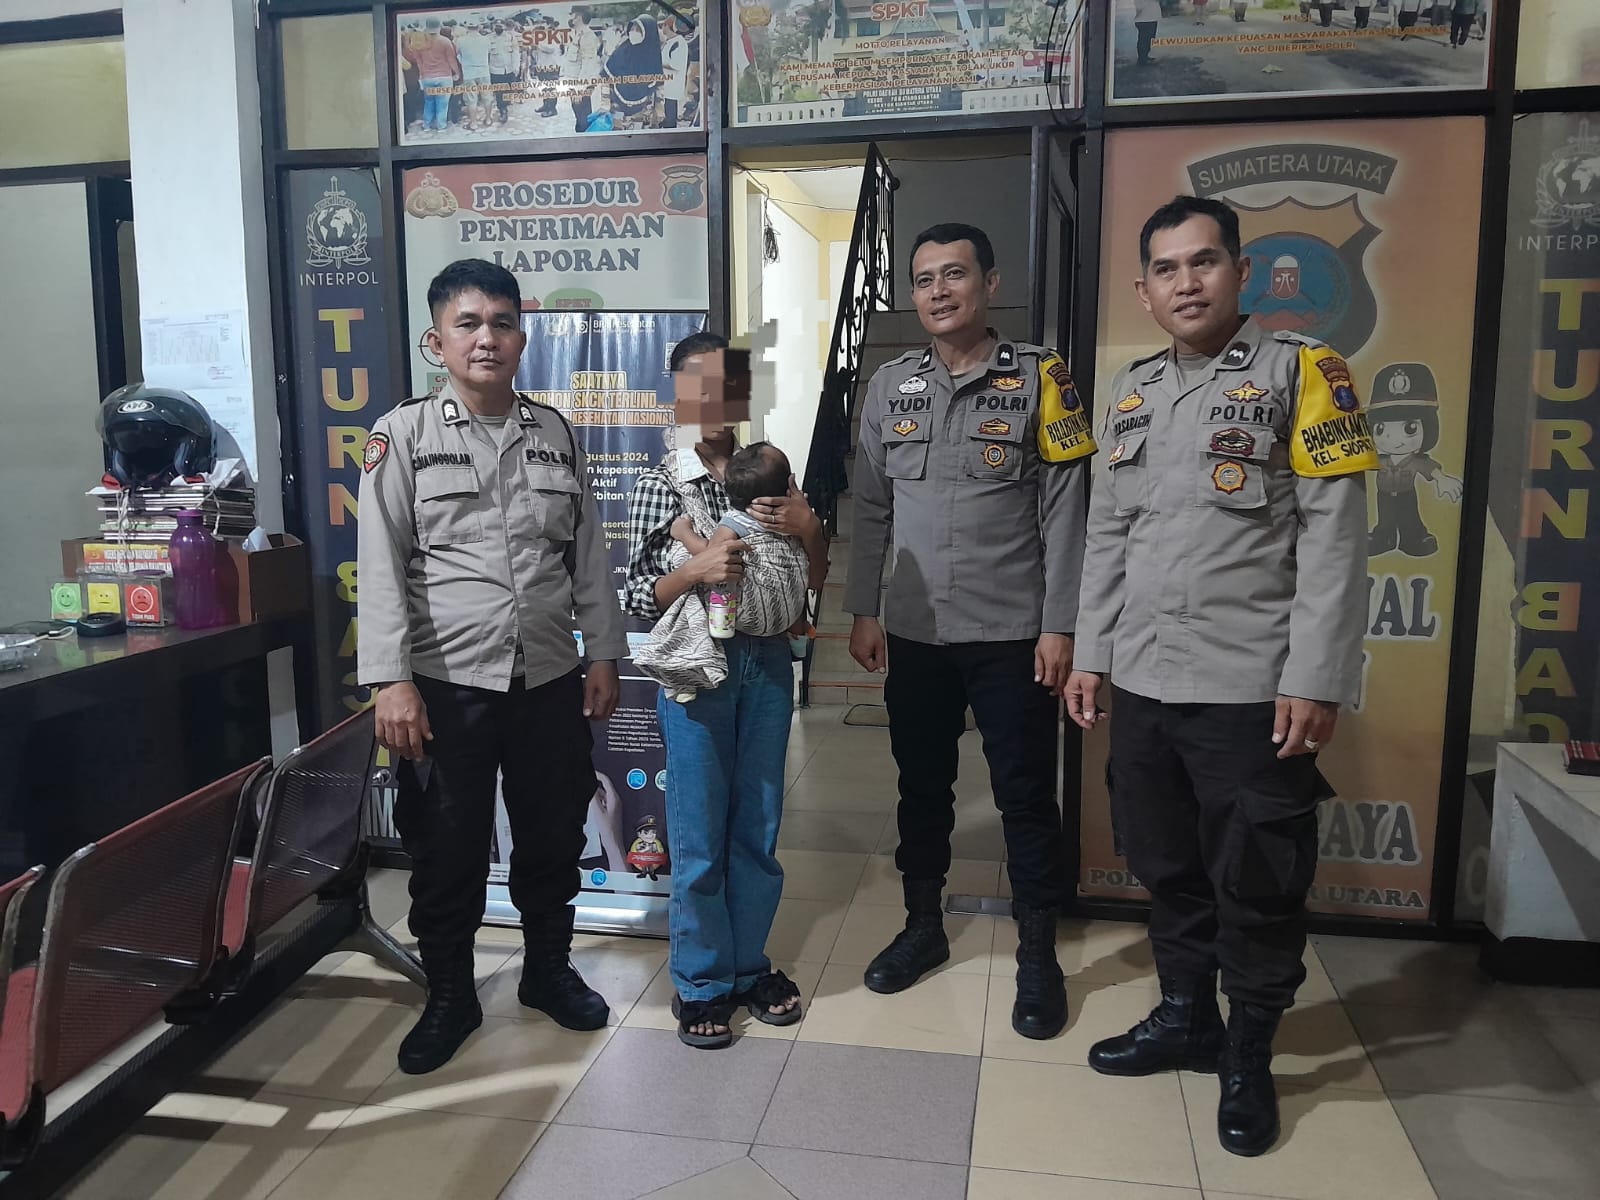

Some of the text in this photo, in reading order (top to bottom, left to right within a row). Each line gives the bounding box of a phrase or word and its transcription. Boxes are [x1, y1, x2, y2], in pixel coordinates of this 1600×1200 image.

[871, 1, 928, 21] SPKT
[521, 28, 571, 46] SPKT
[855, 38, 945, 49] MOTTO PELAYANAN
[1151, 36, 1224, 47] MEWUJUDKAN
[1225, 33, 1283, 43] KEPUASAN
[1284, 30, 1350, 40] MASYARAKAT
[1237, 42, 1356, 55] YANG DIBERIKAN POLRI
[780, 63, 802, 71] KAMI
[804, 60, 846, 70] MEMANG
[847, 58, 879, 67] BELUM
[880, 54, 933, 66] SEMPURNA
[934, 52, 966, 61] TETAPI
[968, 51, 992, 59] KAMI
[789, 61, 1015, 82] BERUSAHA KEPUASAN MASYARAKAT TOLAK UKUR
[563, 78, 589, 86] PRIMA
[591, 76, 621, 85] DALAM
[823, 75, 976, 91] KEBERHASILAN PELAYANAN KAMI
[503, 89, 593, 100] KEPADA MASYARAKAT
[1198, 153, 1386, 188] SUMATERA UTARA
[474, 179, 640, 208] PROSEDUR
[460, 214, 665, 242] PENERIMAAN
[493, 248, 640, 273] LAPORAN
[300, 271, 379, 287] INTERPOL
[572, 372, 626, 390] SAATNYA
[575, 391, 606, 409] SKCK
[888, 397, 931, 413] YUDI
[975, 396, 1027, 411] POLRI
[572, 411, 624, 425] KESEHATAN
[626, 411, 673, 425] NASIONAL
[1209, 405, 1274, 424] POLRI
[1060, 436, 1085, 451] KEL.
[526, 449, 572, 467] POLRI
[622, 452, 649, 462] 2024
[1311, 449, 1340, 468] KEL.
[591, 478, 617, 487] Aktif
[1317, 802, 1417, 862] AYA
[1328, 887, 1424, 908] UTARA
